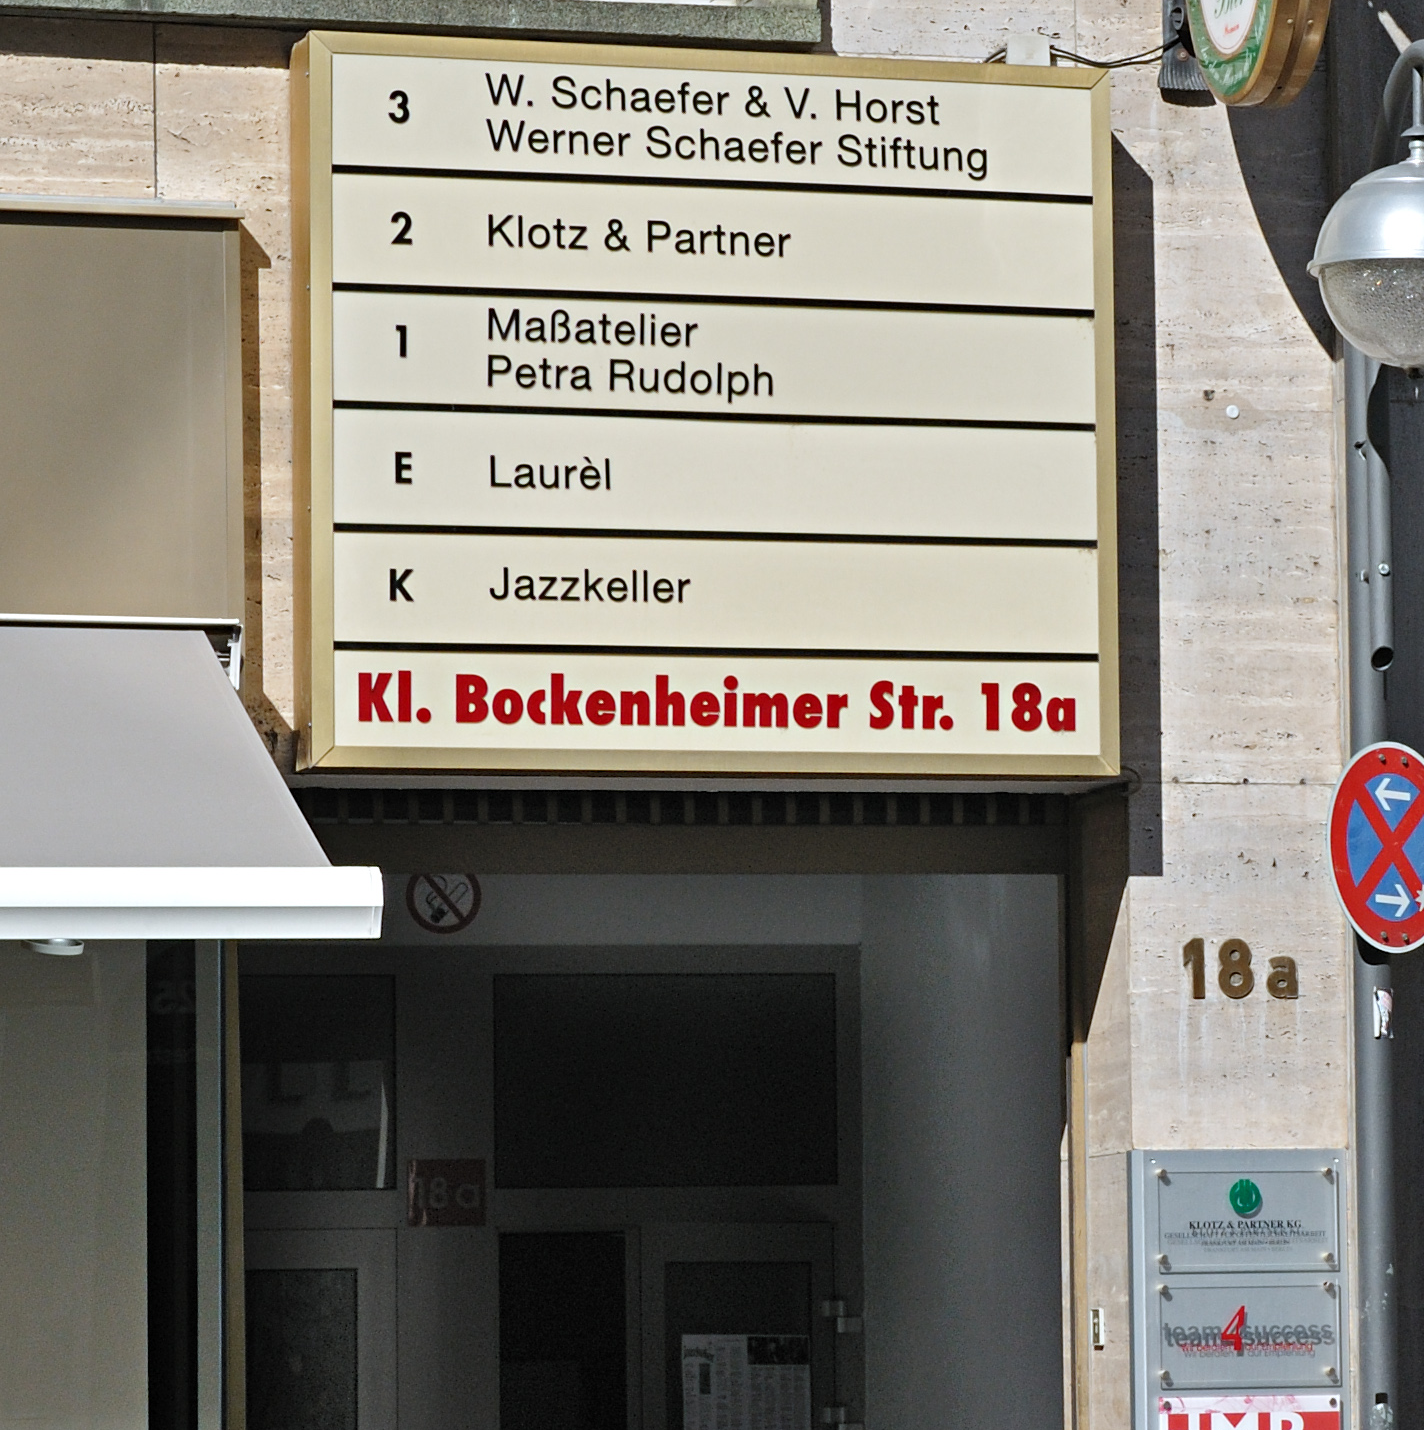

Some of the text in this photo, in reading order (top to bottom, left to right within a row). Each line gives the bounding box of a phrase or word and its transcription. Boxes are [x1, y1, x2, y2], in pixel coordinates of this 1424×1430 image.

[388, 71, 940, 127] 3 W. Schaefer & V. Horst
[486, 118, 989, 180] Werner Schaefer Stiftung
[389, 212, 791, 259] 2 Klotz & Partner
[394, 308, 698, 358] 1 Maßatelier
[486, 355, 774, 403] Petra Rudolph
[394, 451, 612, 492] E Laurèl
[388, 567, 691, 604] K Jazzkeller
[357, 672, 1078, 733] Kl. Bockenheimer Str. 18a
[1189, 1220, 1224, 1231] KLOTZ
[1237, 1219, 1285, 1230] PARTNER
